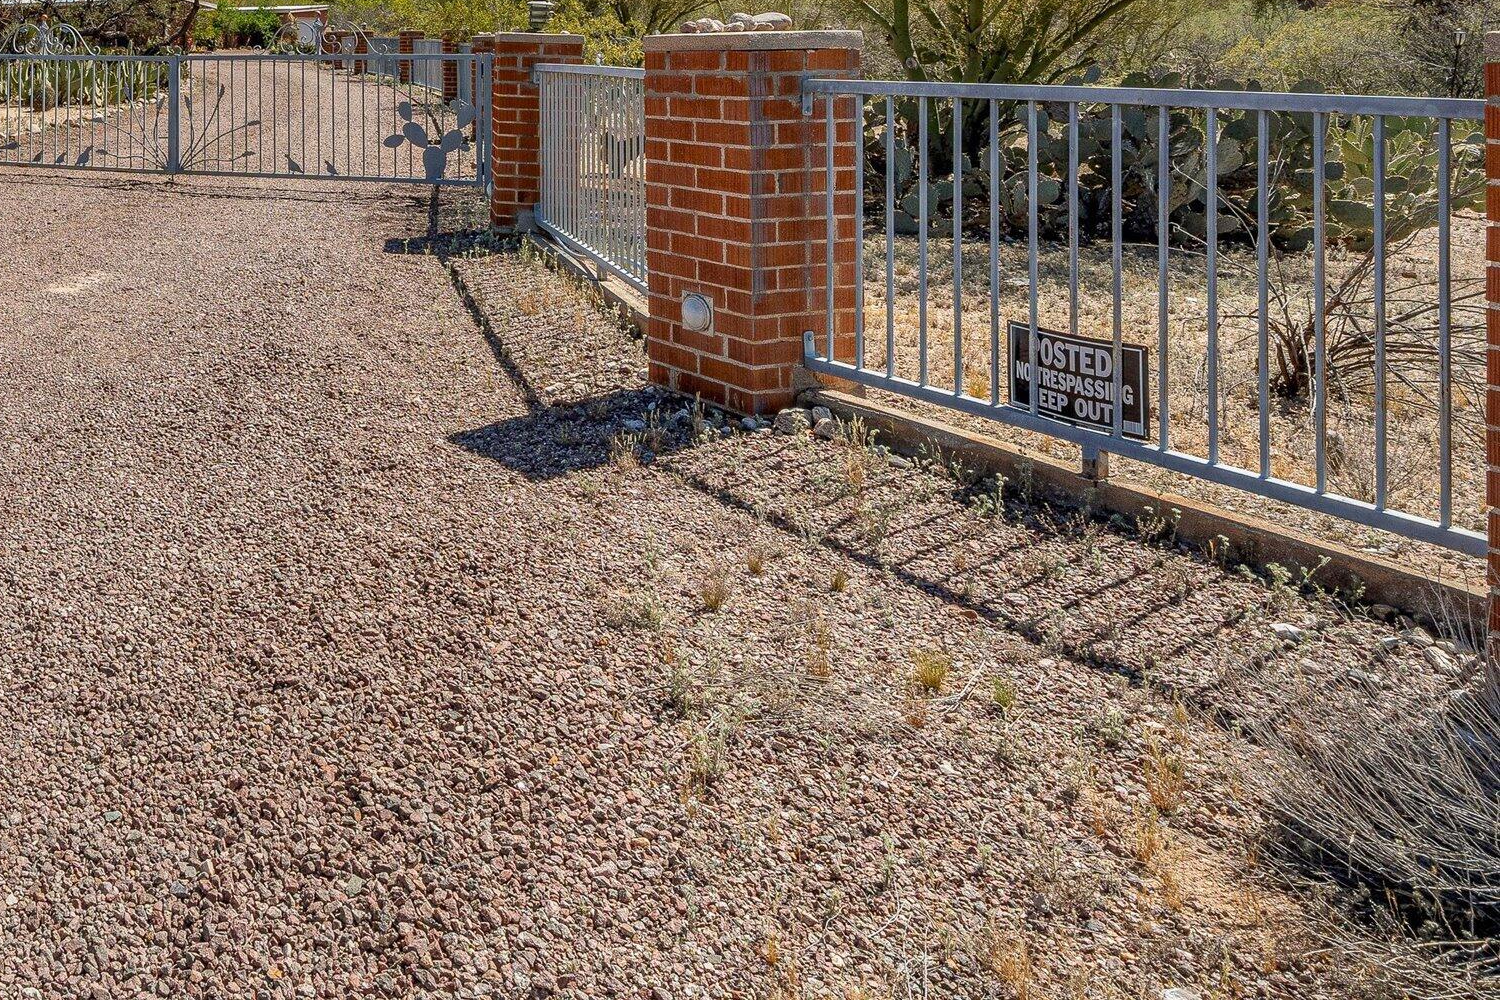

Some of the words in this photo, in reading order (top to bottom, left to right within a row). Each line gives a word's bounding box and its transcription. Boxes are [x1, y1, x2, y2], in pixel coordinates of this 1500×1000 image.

[1016, 360, 1031, 382] NO
[1031, 336, 1113, 378] OSTED
[1035, 387, 1069, 412] EEP
[1074, 397, 1113, 423] OUT
